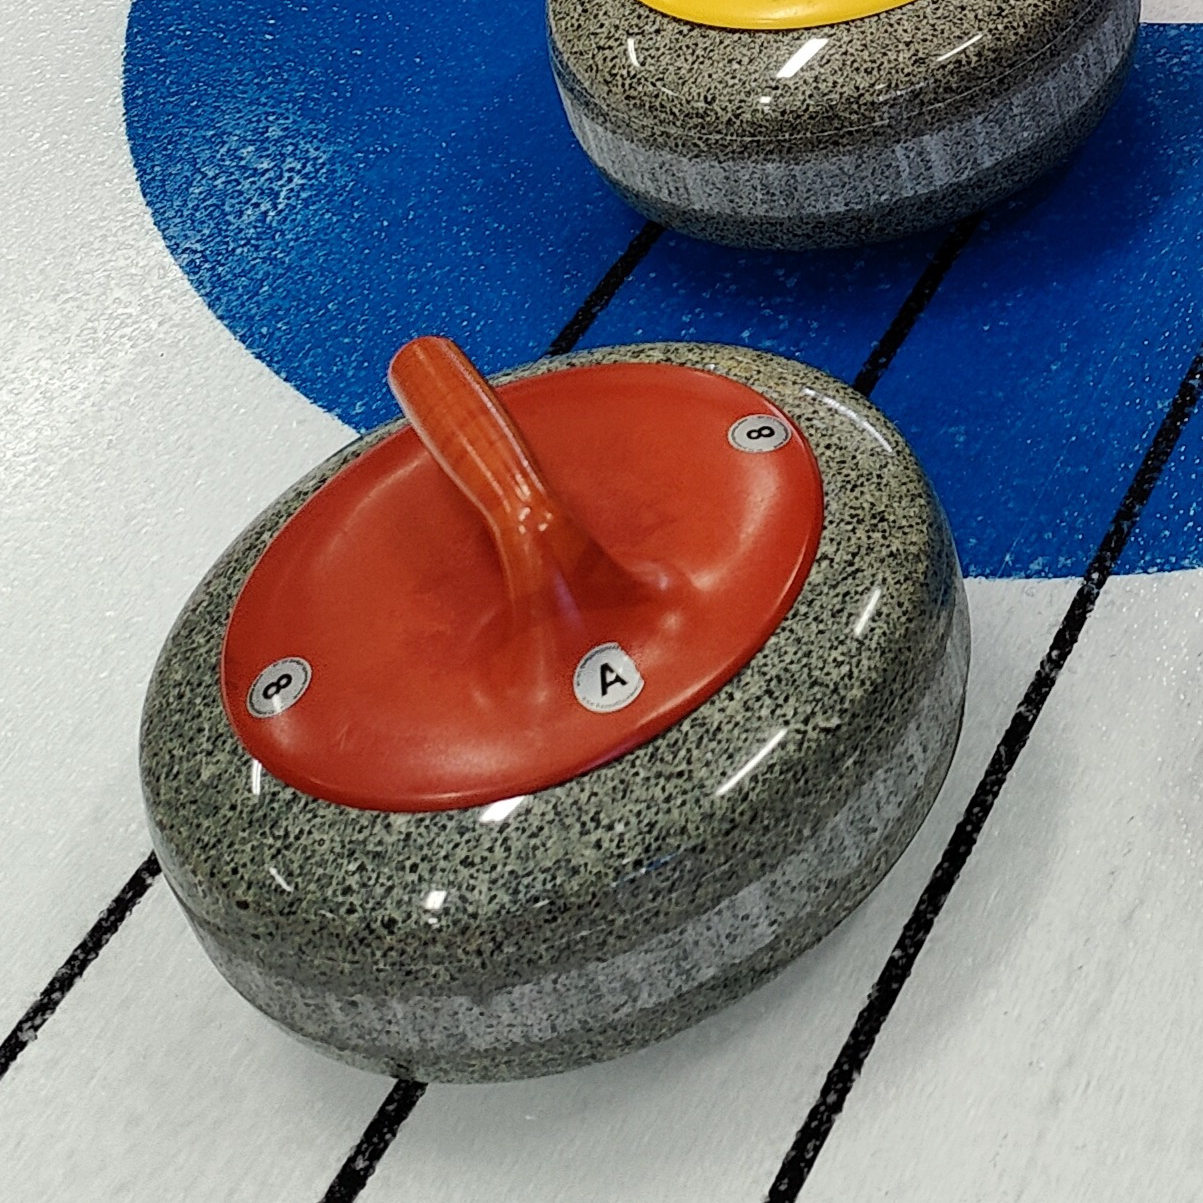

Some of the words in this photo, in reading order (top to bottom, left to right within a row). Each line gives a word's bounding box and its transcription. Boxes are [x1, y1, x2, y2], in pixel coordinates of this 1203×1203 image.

[746, 425, 776, 440] 8
[261, 673, 293, 700] 8
[599, 662, 628, 697] A
